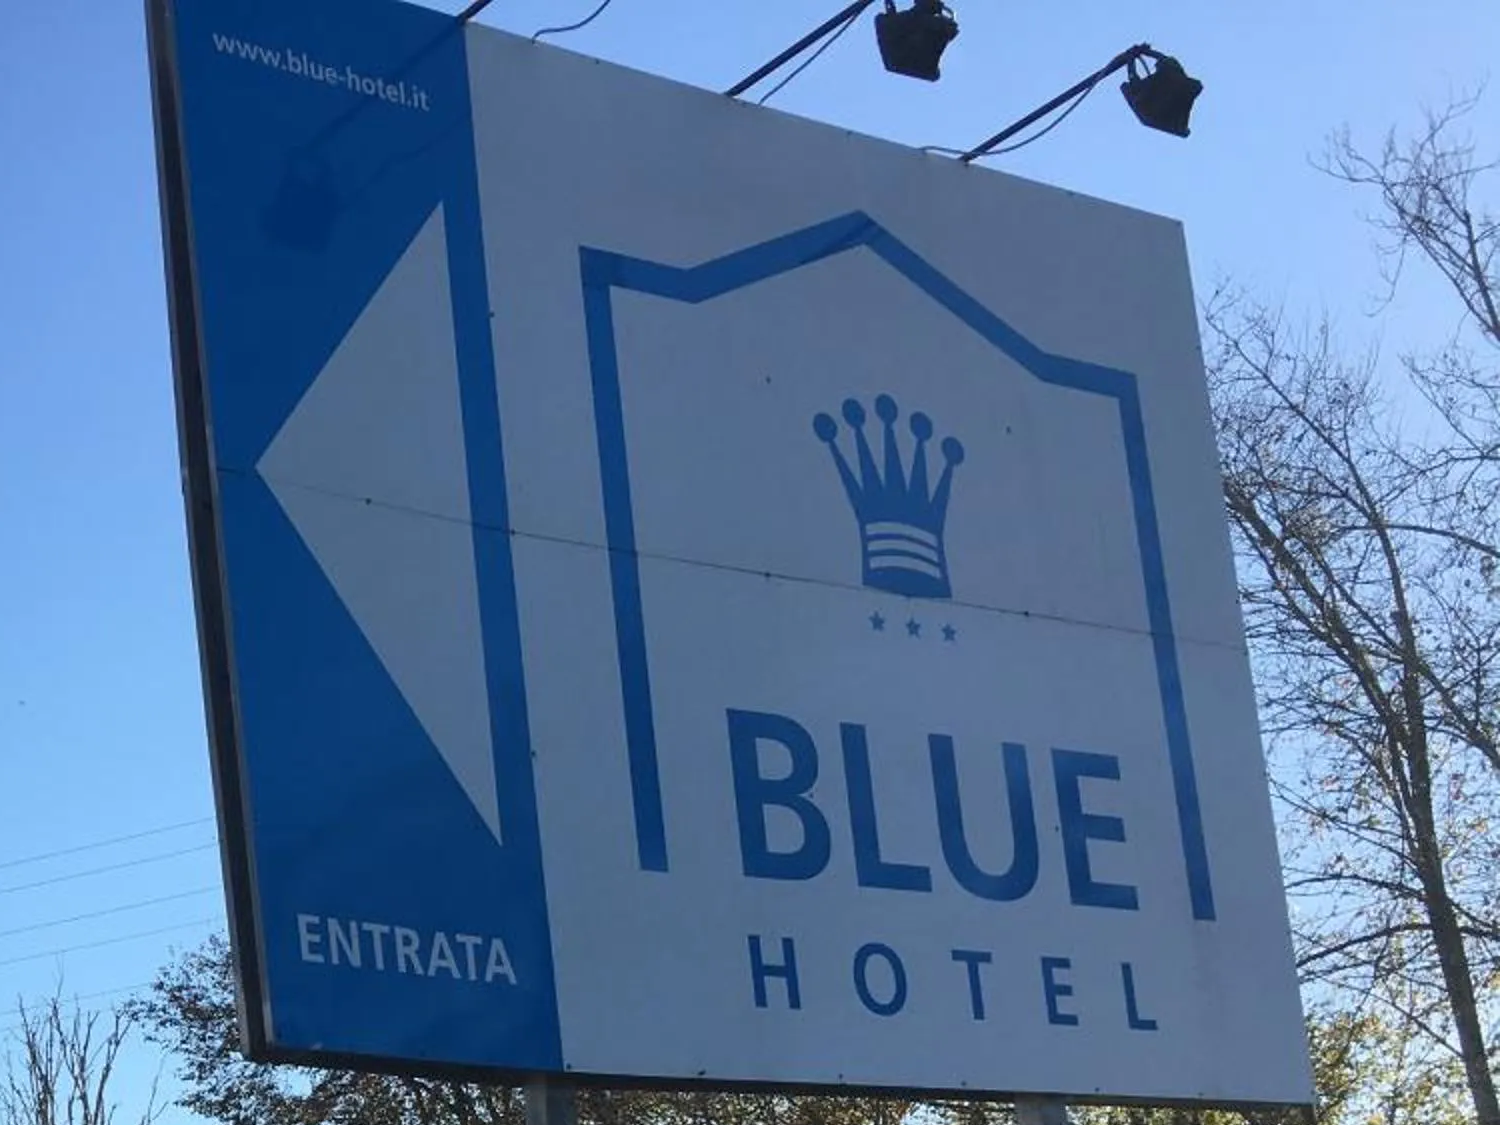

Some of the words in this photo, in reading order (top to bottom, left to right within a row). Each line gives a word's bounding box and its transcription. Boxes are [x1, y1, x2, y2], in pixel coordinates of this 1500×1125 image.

[212, 32, 430, 112] www.blue-hotel.it
[725, 708, 1140, 912] BLUE
[297, 913, 518, 986] ENTRATA
[747, 934, 1159, 1032] HOTEL
